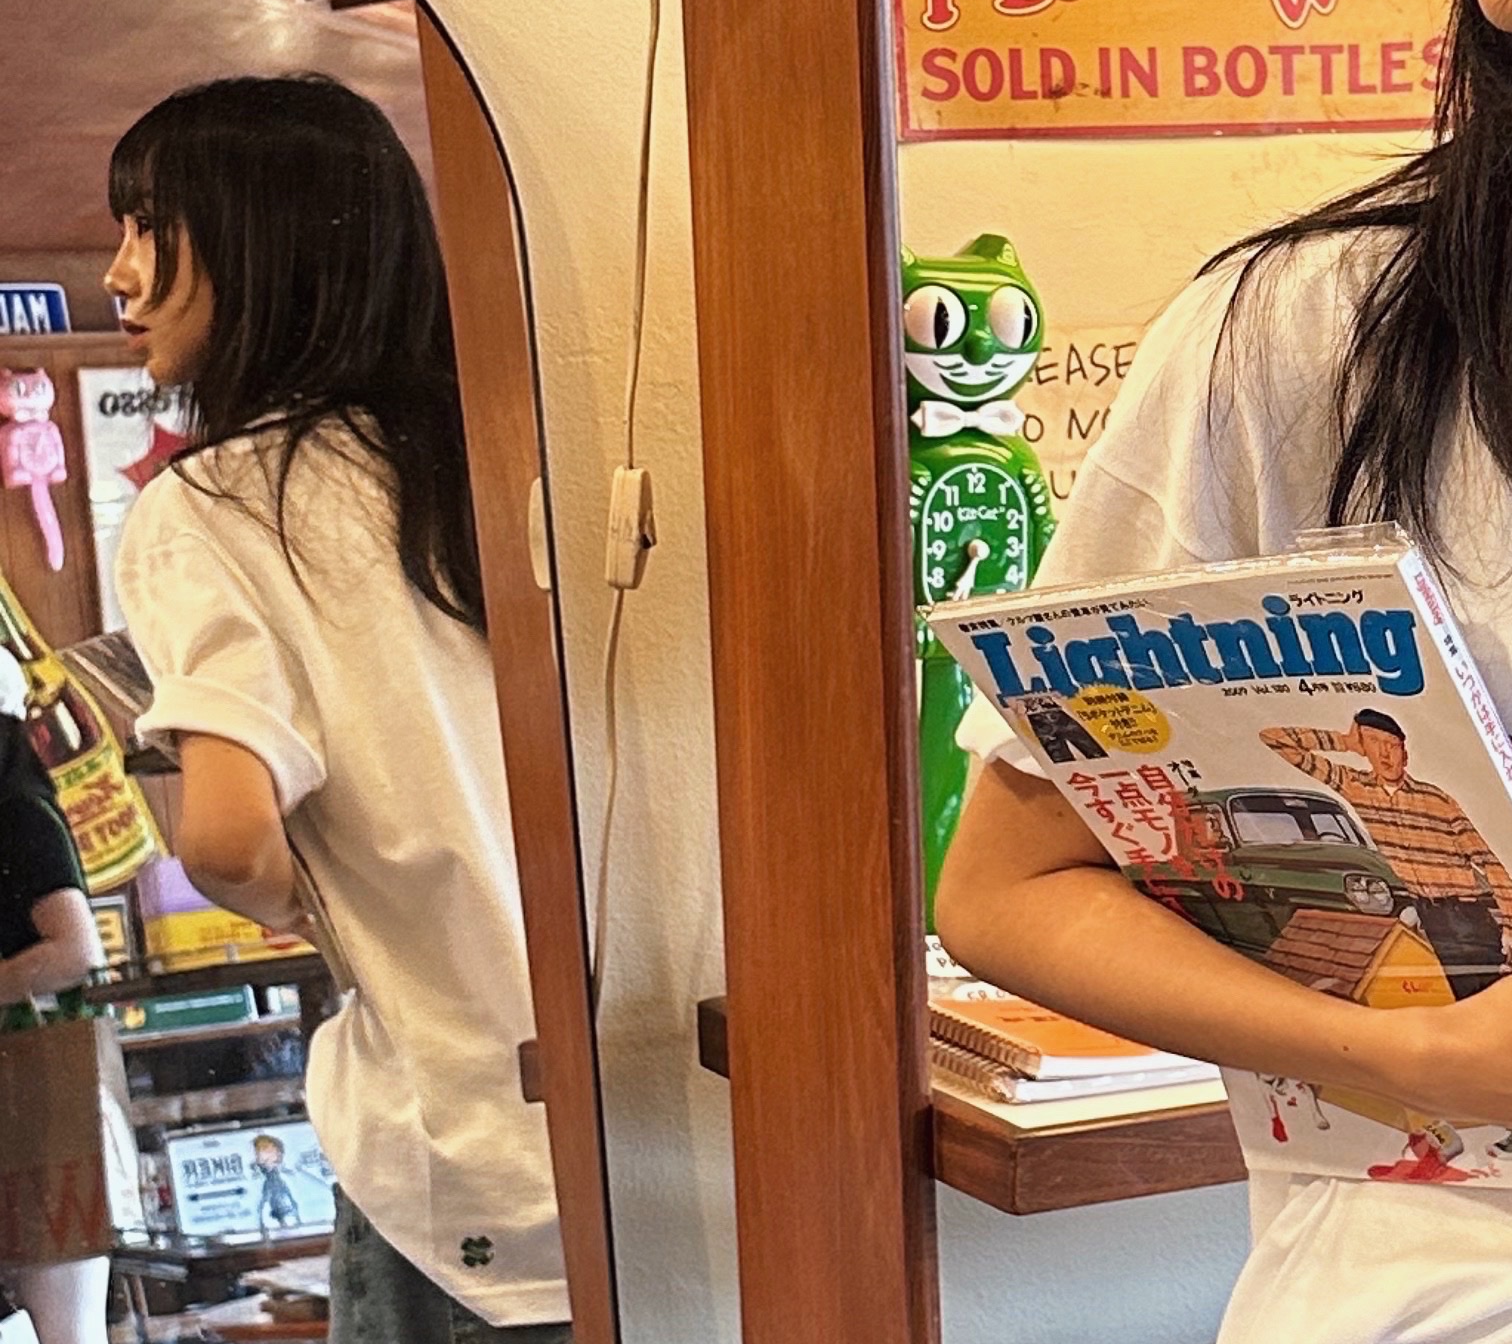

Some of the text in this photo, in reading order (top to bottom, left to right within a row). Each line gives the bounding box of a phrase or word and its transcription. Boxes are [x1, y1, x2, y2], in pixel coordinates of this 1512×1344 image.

[920, 47, 1076, 103] SOLD
[1100, 47, 1158, 99] IN
[1029, 342, 1136, 387] EASE
[966, 472, 987, 494] 12
[998, 483, 1007, 505] 1
[943, 485, 960, 507] 11
[932, 510, 954, 533] 10
[1006, 508, 1020, 530] 2
[931, 539, 947, 561] 9
[1006, 536, 1020, 557] 3
[930, 567, 945, 589] 8
[1005, 564, 1020, 585] 4
[1288, 589, 1364, 607] ライトニング
[970, 594, 1425, 708] Lightning
